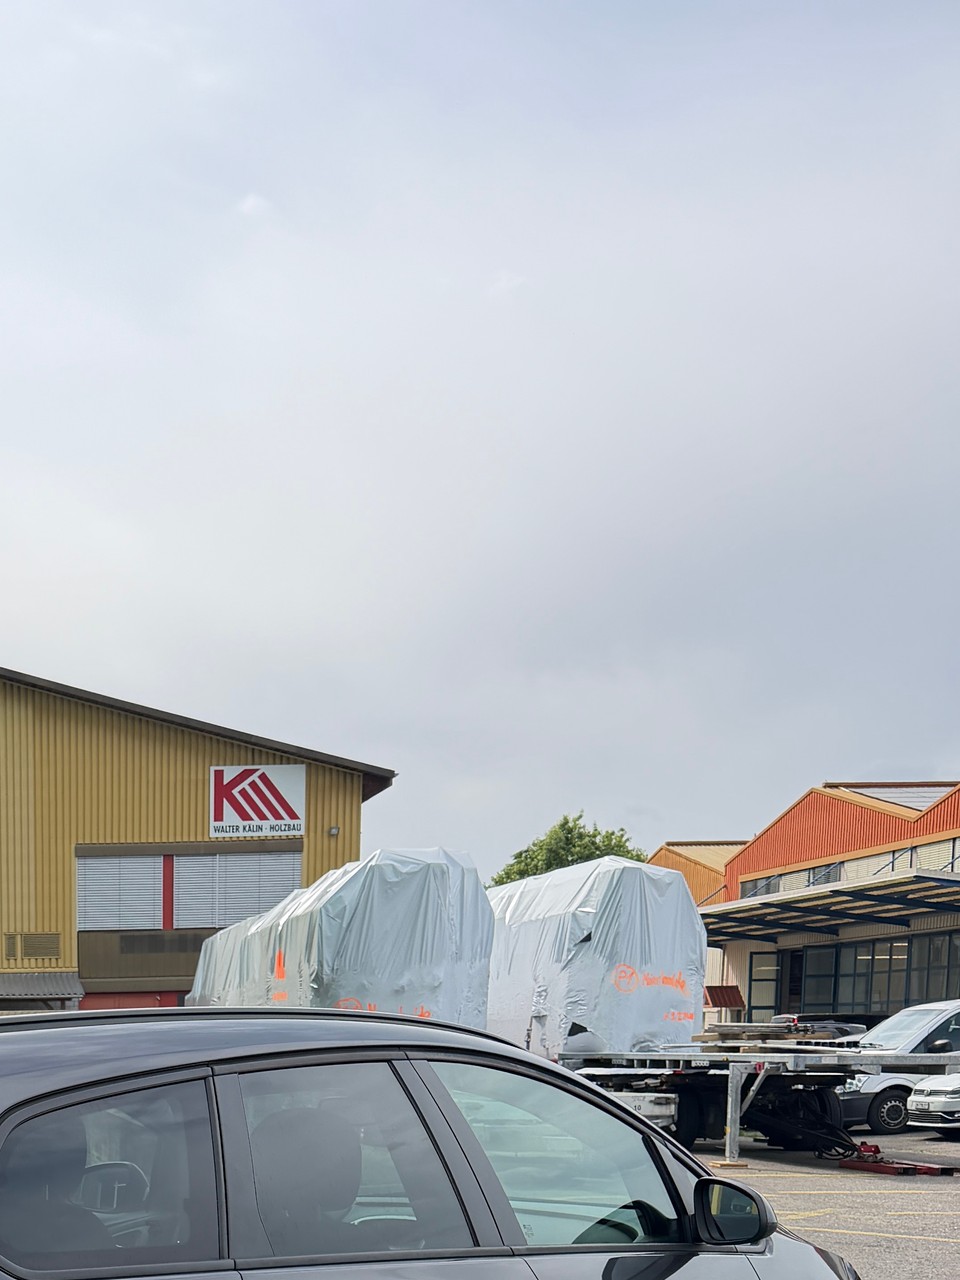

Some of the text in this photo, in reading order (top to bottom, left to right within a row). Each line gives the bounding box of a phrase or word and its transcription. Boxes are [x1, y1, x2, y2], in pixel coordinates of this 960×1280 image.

[213, 824, 240, 834] WALTER
[242, 823, 263, 833] KÄLIN
[269, 823, 302, 833] HOLZBAU
